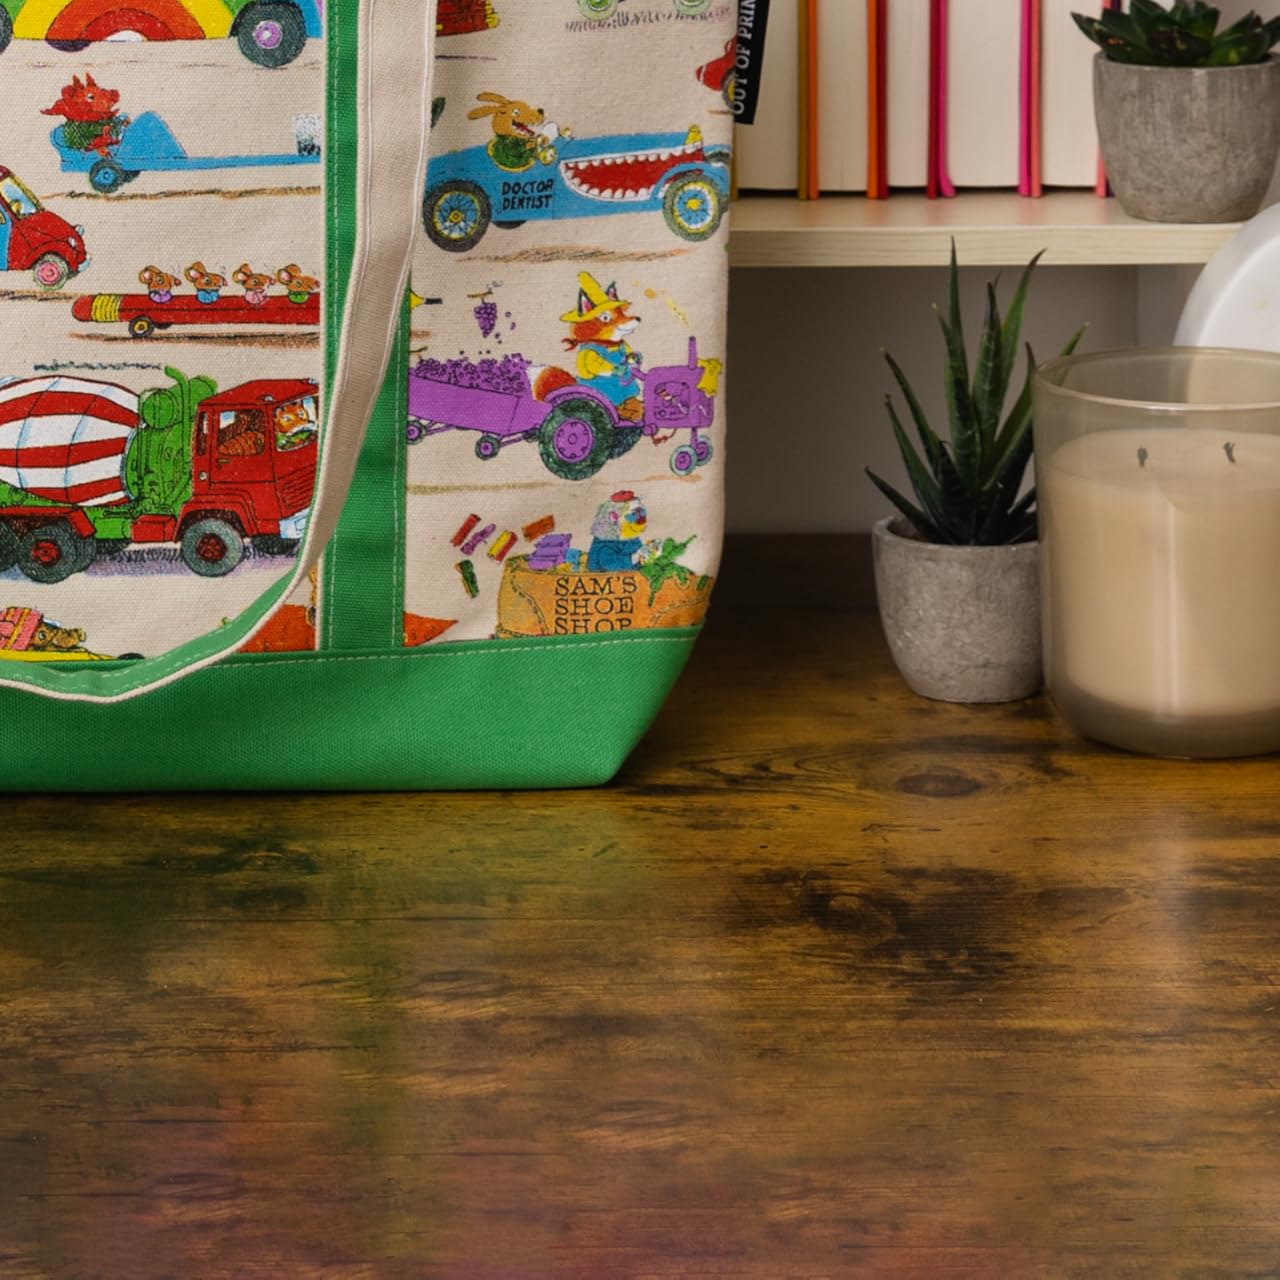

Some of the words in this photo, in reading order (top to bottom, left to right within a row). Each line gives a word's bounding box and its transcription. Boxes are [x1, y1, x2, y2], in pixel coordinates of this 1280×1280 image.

[735, 44, 751, 69] OF
[732, 72, 748, 114] OUT
[502, 178, 554, 195] DOCTOR
[503, 194, 553, 211] DENTIST
[554, 576, 637, 596] SAM'S
[554, 596, 634, 615] SHOE
[554, 617, 632, 635] SHOP
